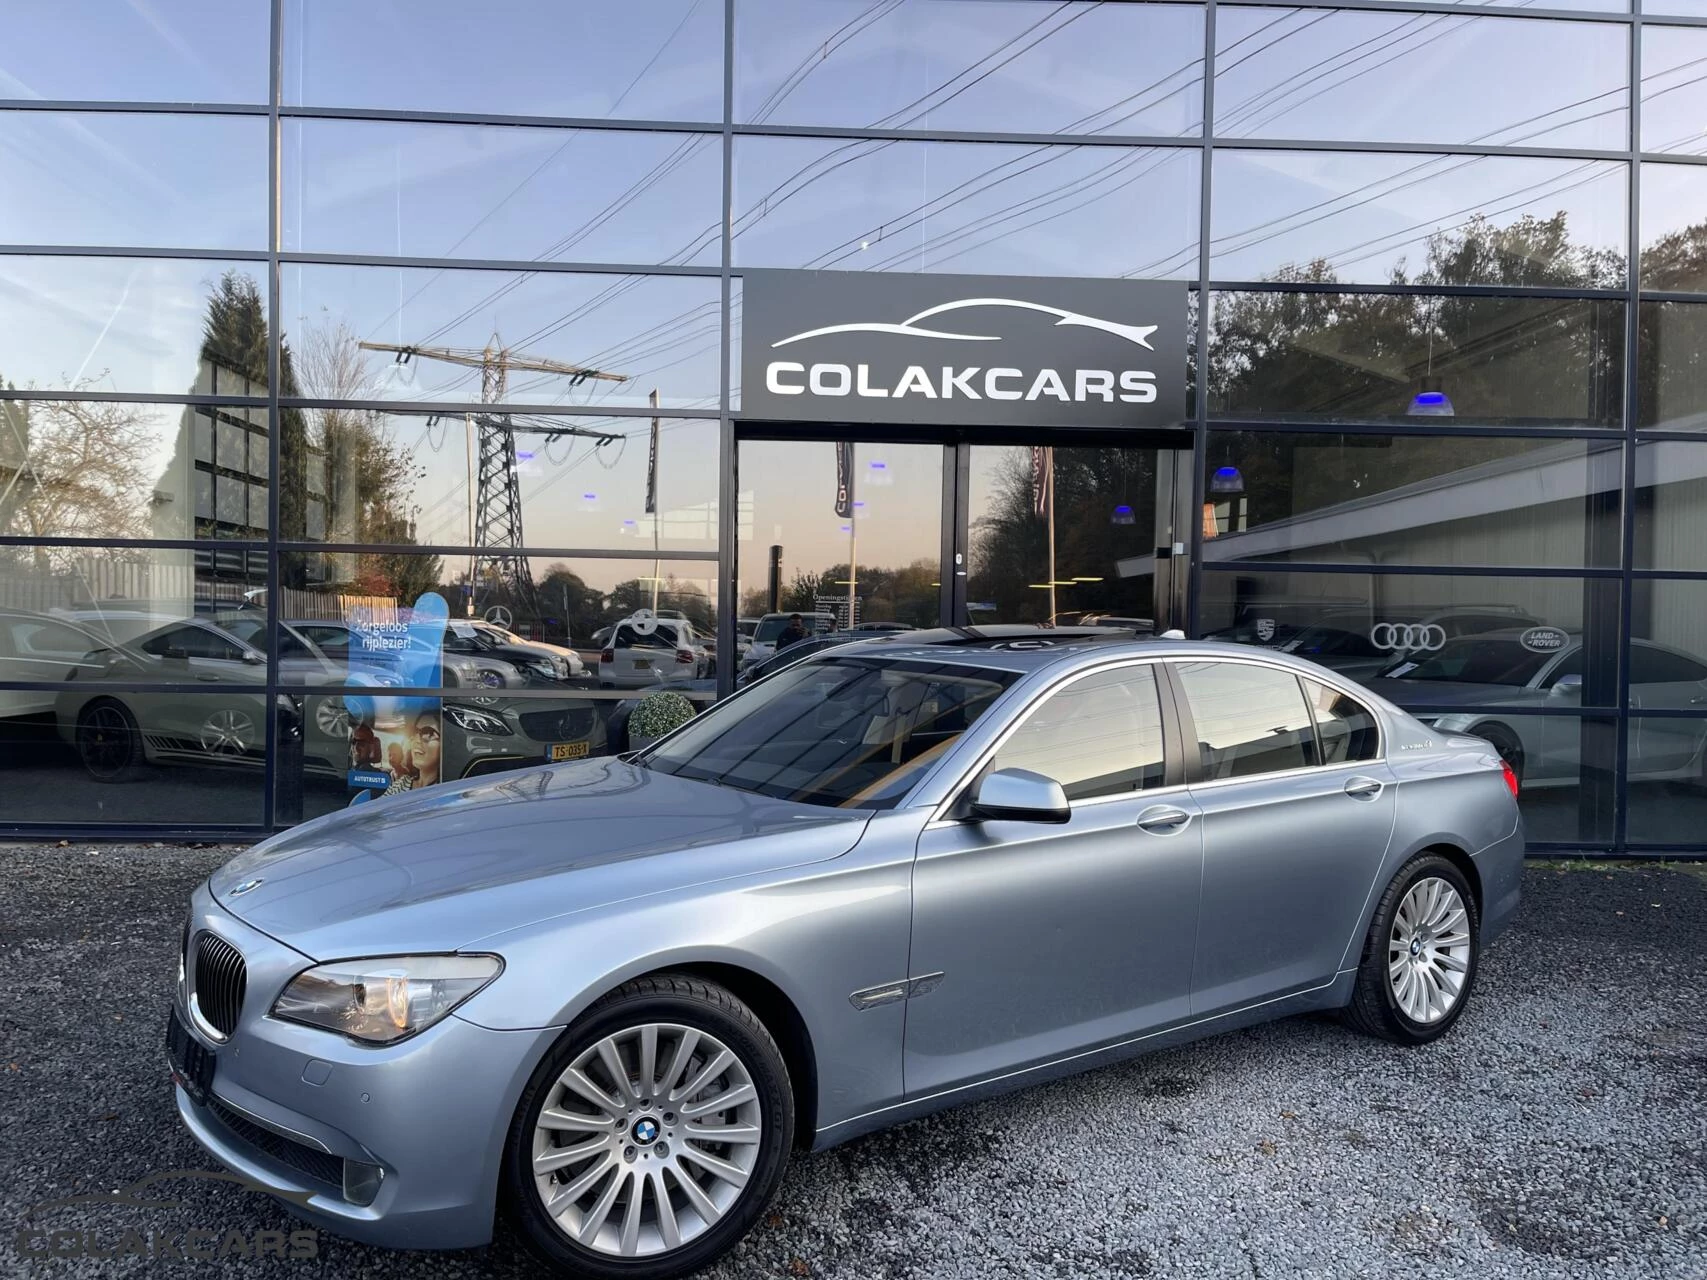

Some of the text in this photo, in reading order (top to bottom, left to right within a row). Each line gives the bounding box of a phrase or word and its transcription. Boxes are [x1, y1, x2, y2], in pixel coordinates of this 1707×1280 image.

[766, 361, 1158, 403] COLAKCARS
[362, 635, 411, 652] rijplezier!
[1532, 639, 1561, 647] ROVER
